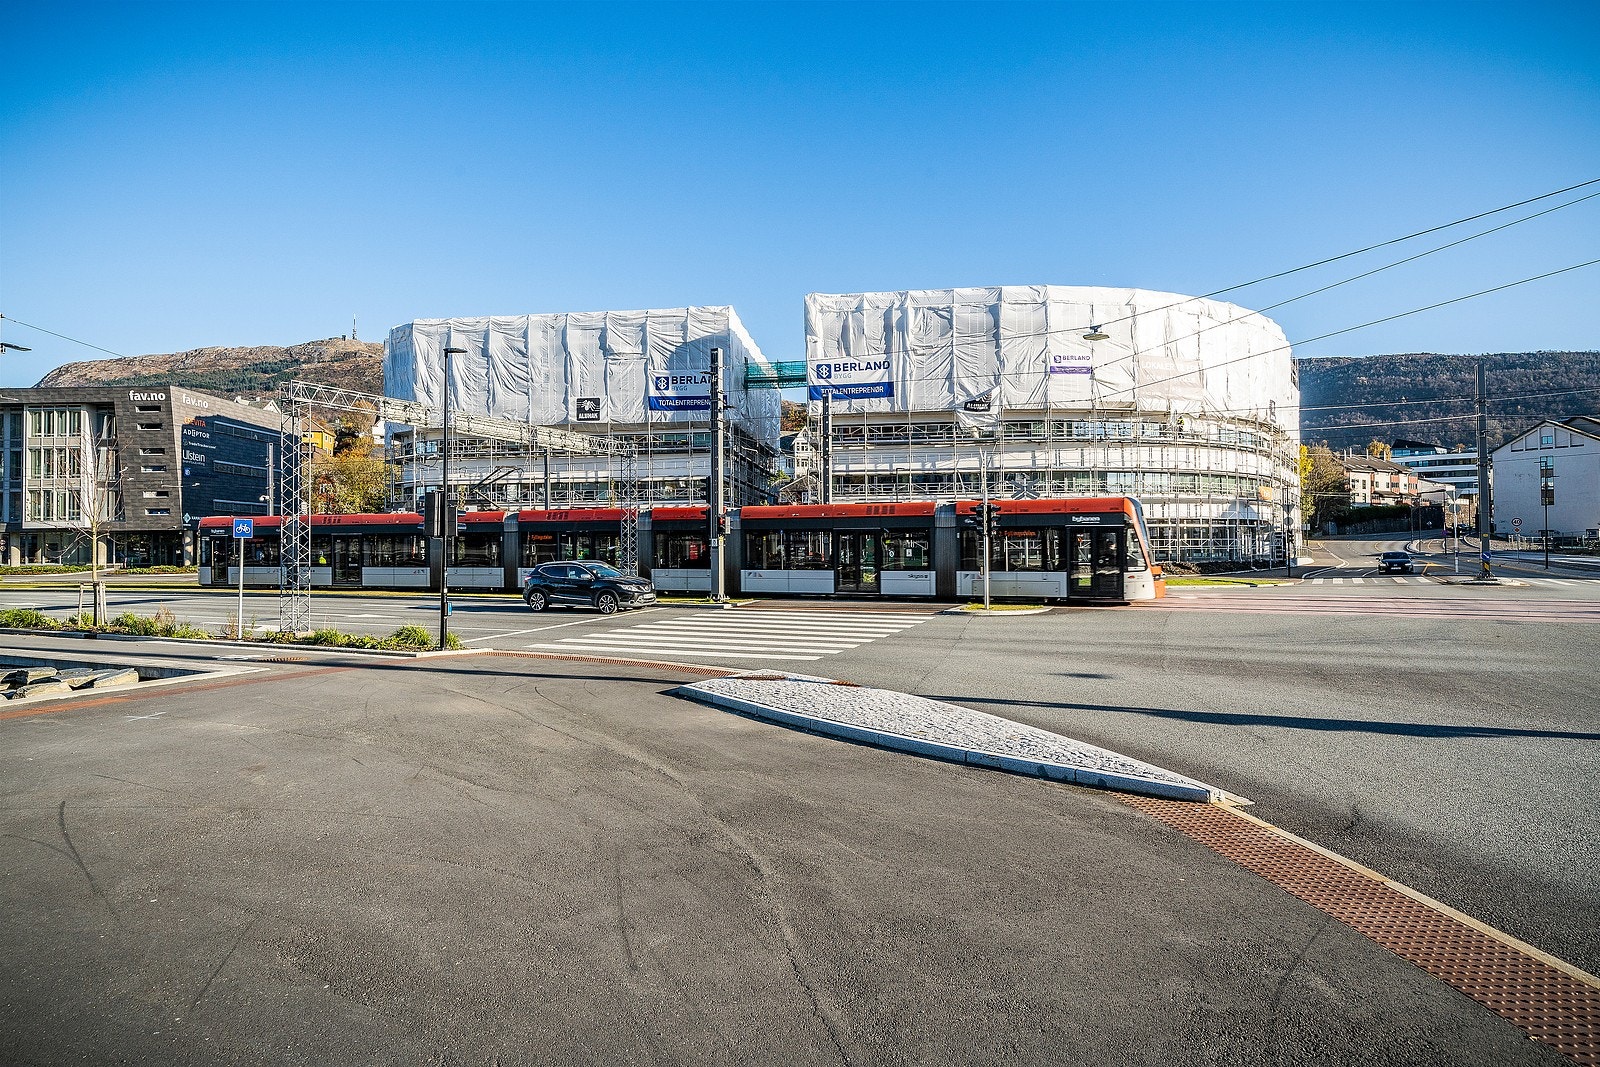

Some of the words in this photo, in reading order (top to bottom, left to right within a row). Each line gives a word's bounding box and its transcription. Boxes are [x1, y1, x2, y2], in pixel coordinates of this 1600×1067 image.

[833, 361, 890, 372] BERLAND
[129, 390, 166, 401] fav.no
[820, 385, 884, 395] TOTALENTREPRENØR
[182, 393, 209, 409] fav.no
